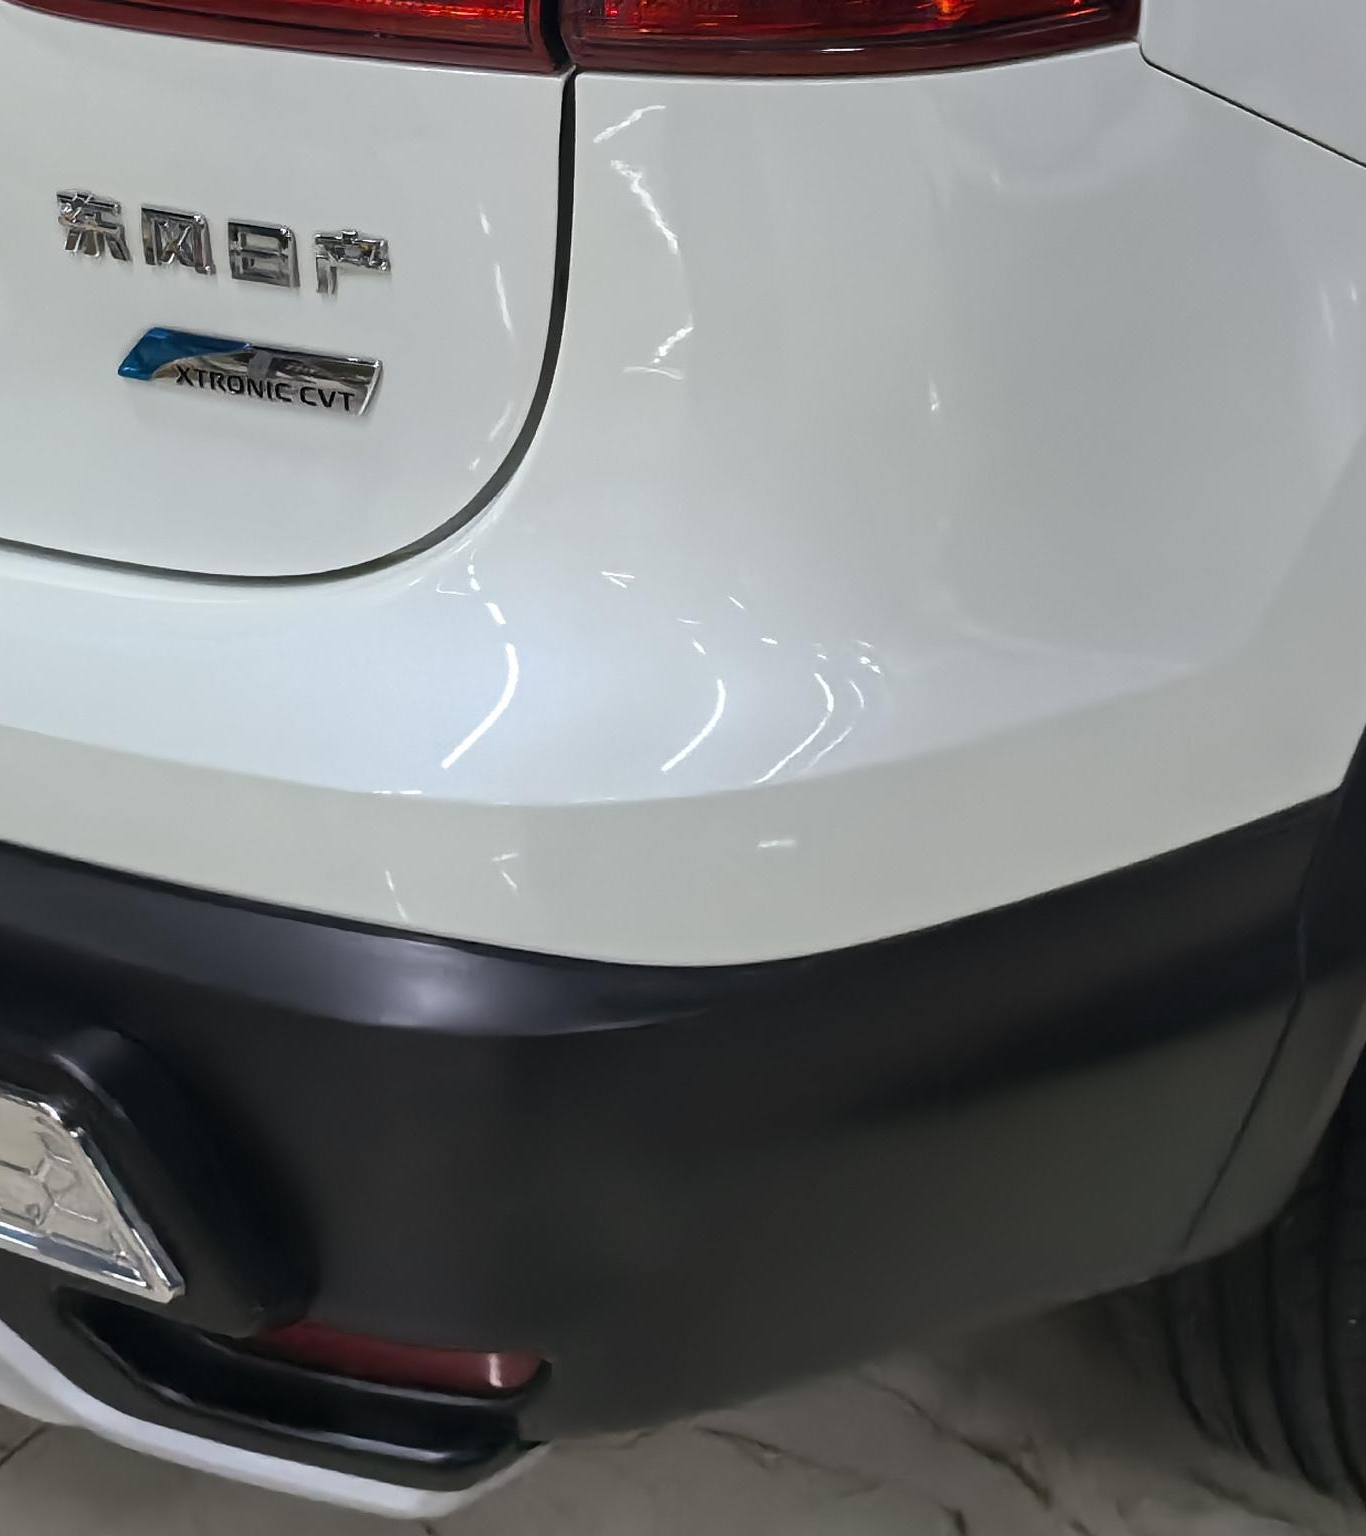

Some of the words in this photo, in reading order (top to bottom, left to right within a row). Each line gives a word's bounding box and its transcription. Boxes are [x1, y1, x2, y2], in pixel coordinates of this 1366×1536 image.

[55, 189, 391, 298] 东风日产
[175, 364, 293, 404] XTRONIC
[299, 385, 356, 412] CVT
